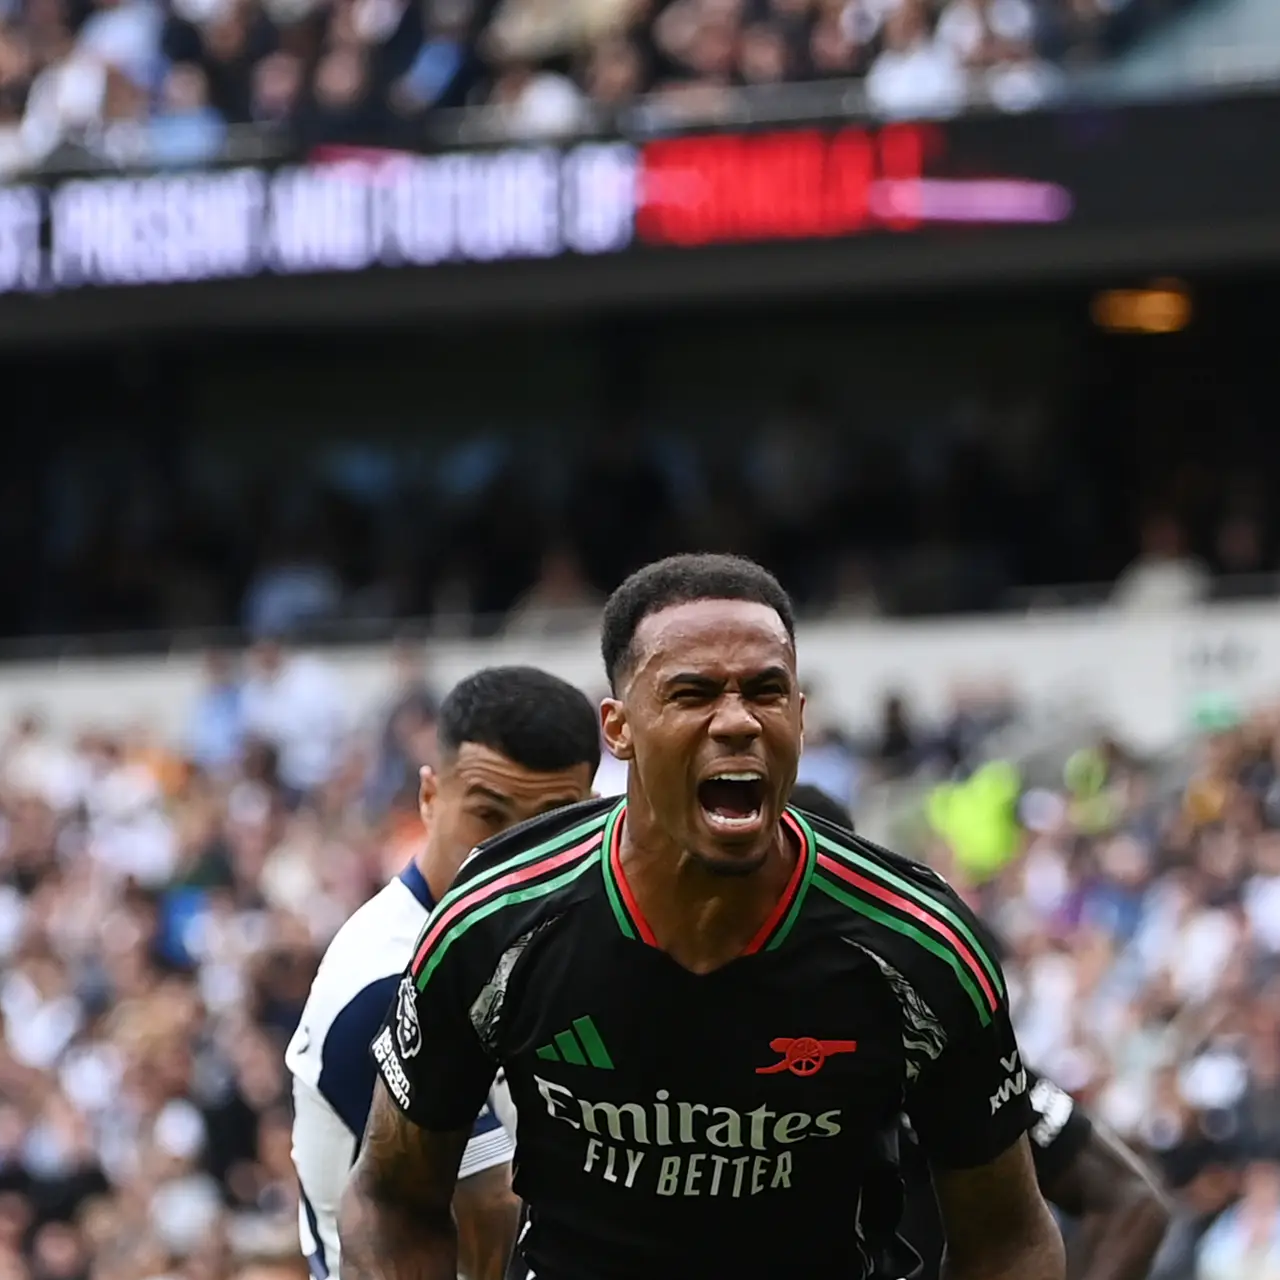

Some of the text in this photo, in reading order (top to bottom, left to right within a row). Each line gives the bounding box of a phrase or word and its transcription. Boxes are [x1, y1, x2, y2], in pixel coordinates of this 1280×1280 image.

[533, 1074, 842, 1150] Emirates
[583, 1138, 792, 1197] FLY BETTER
